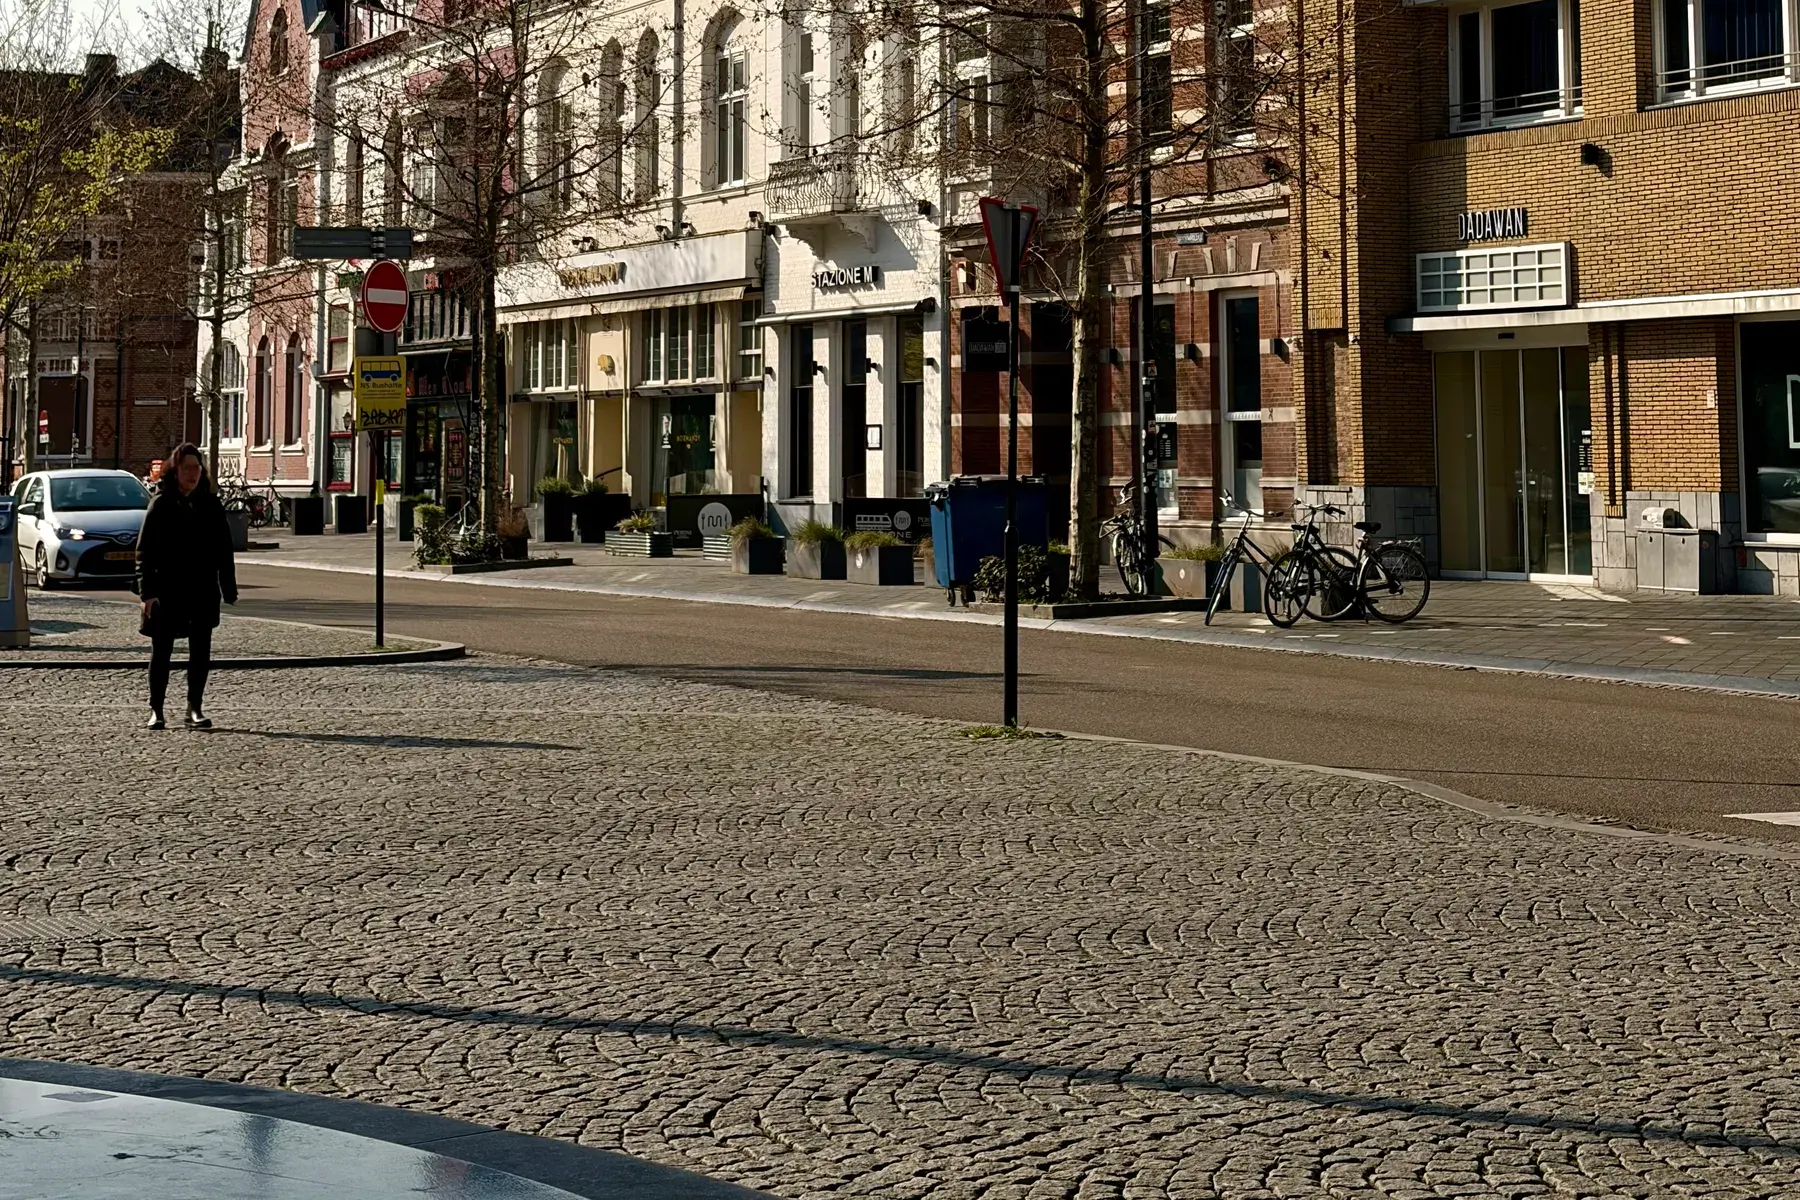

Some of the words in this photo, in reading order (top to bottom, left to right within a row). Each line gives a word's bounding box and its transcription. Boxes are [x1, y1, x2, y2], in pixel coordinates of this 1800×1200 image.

[1458, 207, 1524, 240] DADAWAN
[810, 267, 861, 288] STAZIONE
[863, 266, 873, 283] M
